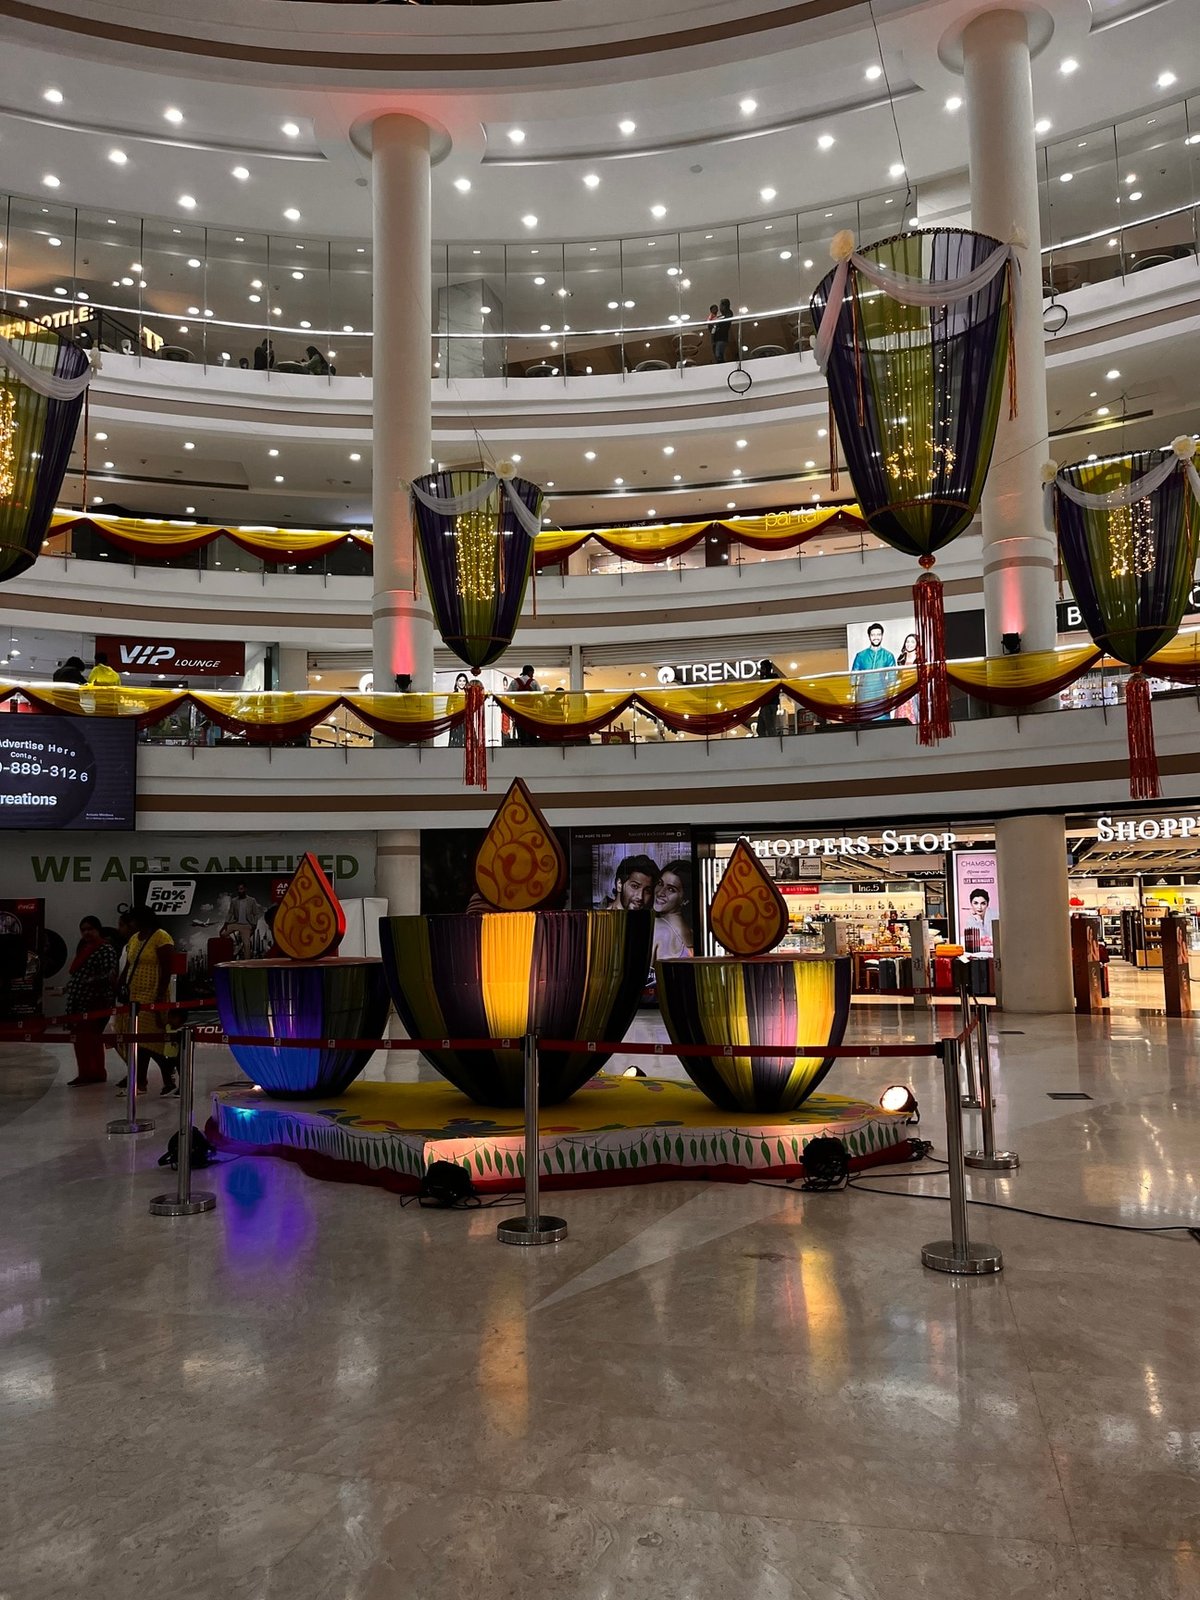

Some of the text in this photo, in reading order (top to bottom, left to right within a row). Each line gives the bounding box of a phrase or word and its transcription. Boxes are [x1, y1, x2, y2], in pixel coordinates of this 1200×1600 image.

[119, 644, 221, 668] VIP LOUNGE
[676, 659, 772, 683] TREND
[48, 744, 76, 758] Here
[1097, 816, 1200, 842] SHOPP
[737, 829, 957, 858] HOPPERS STOP
[31, 856, 92, 882] WE
[180, 854, 359, 880] SANITIED
[961, 860, 996, 868] CHAMBOR
[151, 890, 186, 901] 50%
[858, 884, 880, 892] Inc.5
